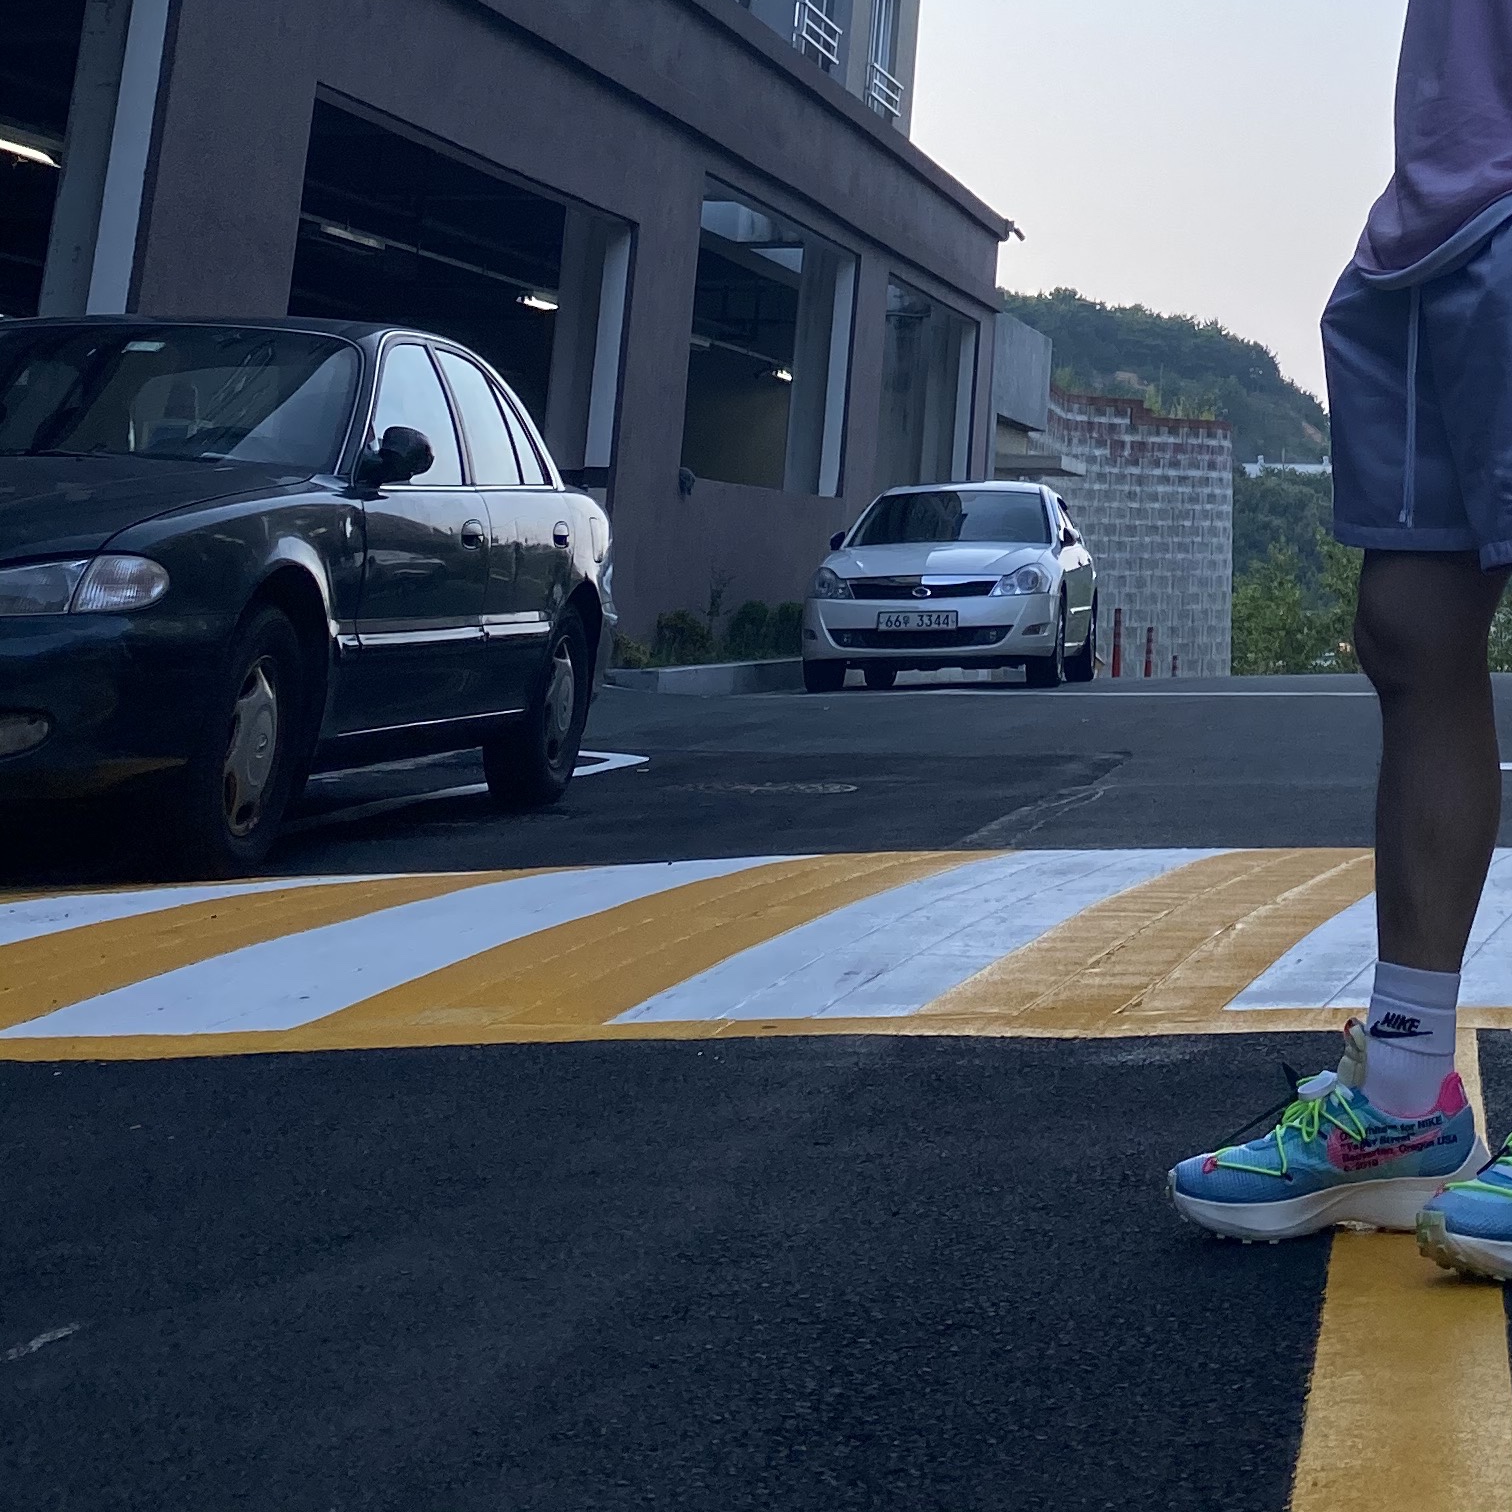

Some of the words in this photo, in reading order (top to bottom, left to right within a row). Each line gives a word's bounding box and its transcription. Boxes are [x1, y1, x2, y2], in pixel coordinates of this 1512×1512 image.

[916, 613, 950, 628] 3344
[1380, 1011, 1421, 1032] NIKE
[1417, 1115, 1443, 1129] NIKE
[1437, 1134, 1458, 1145] USA
